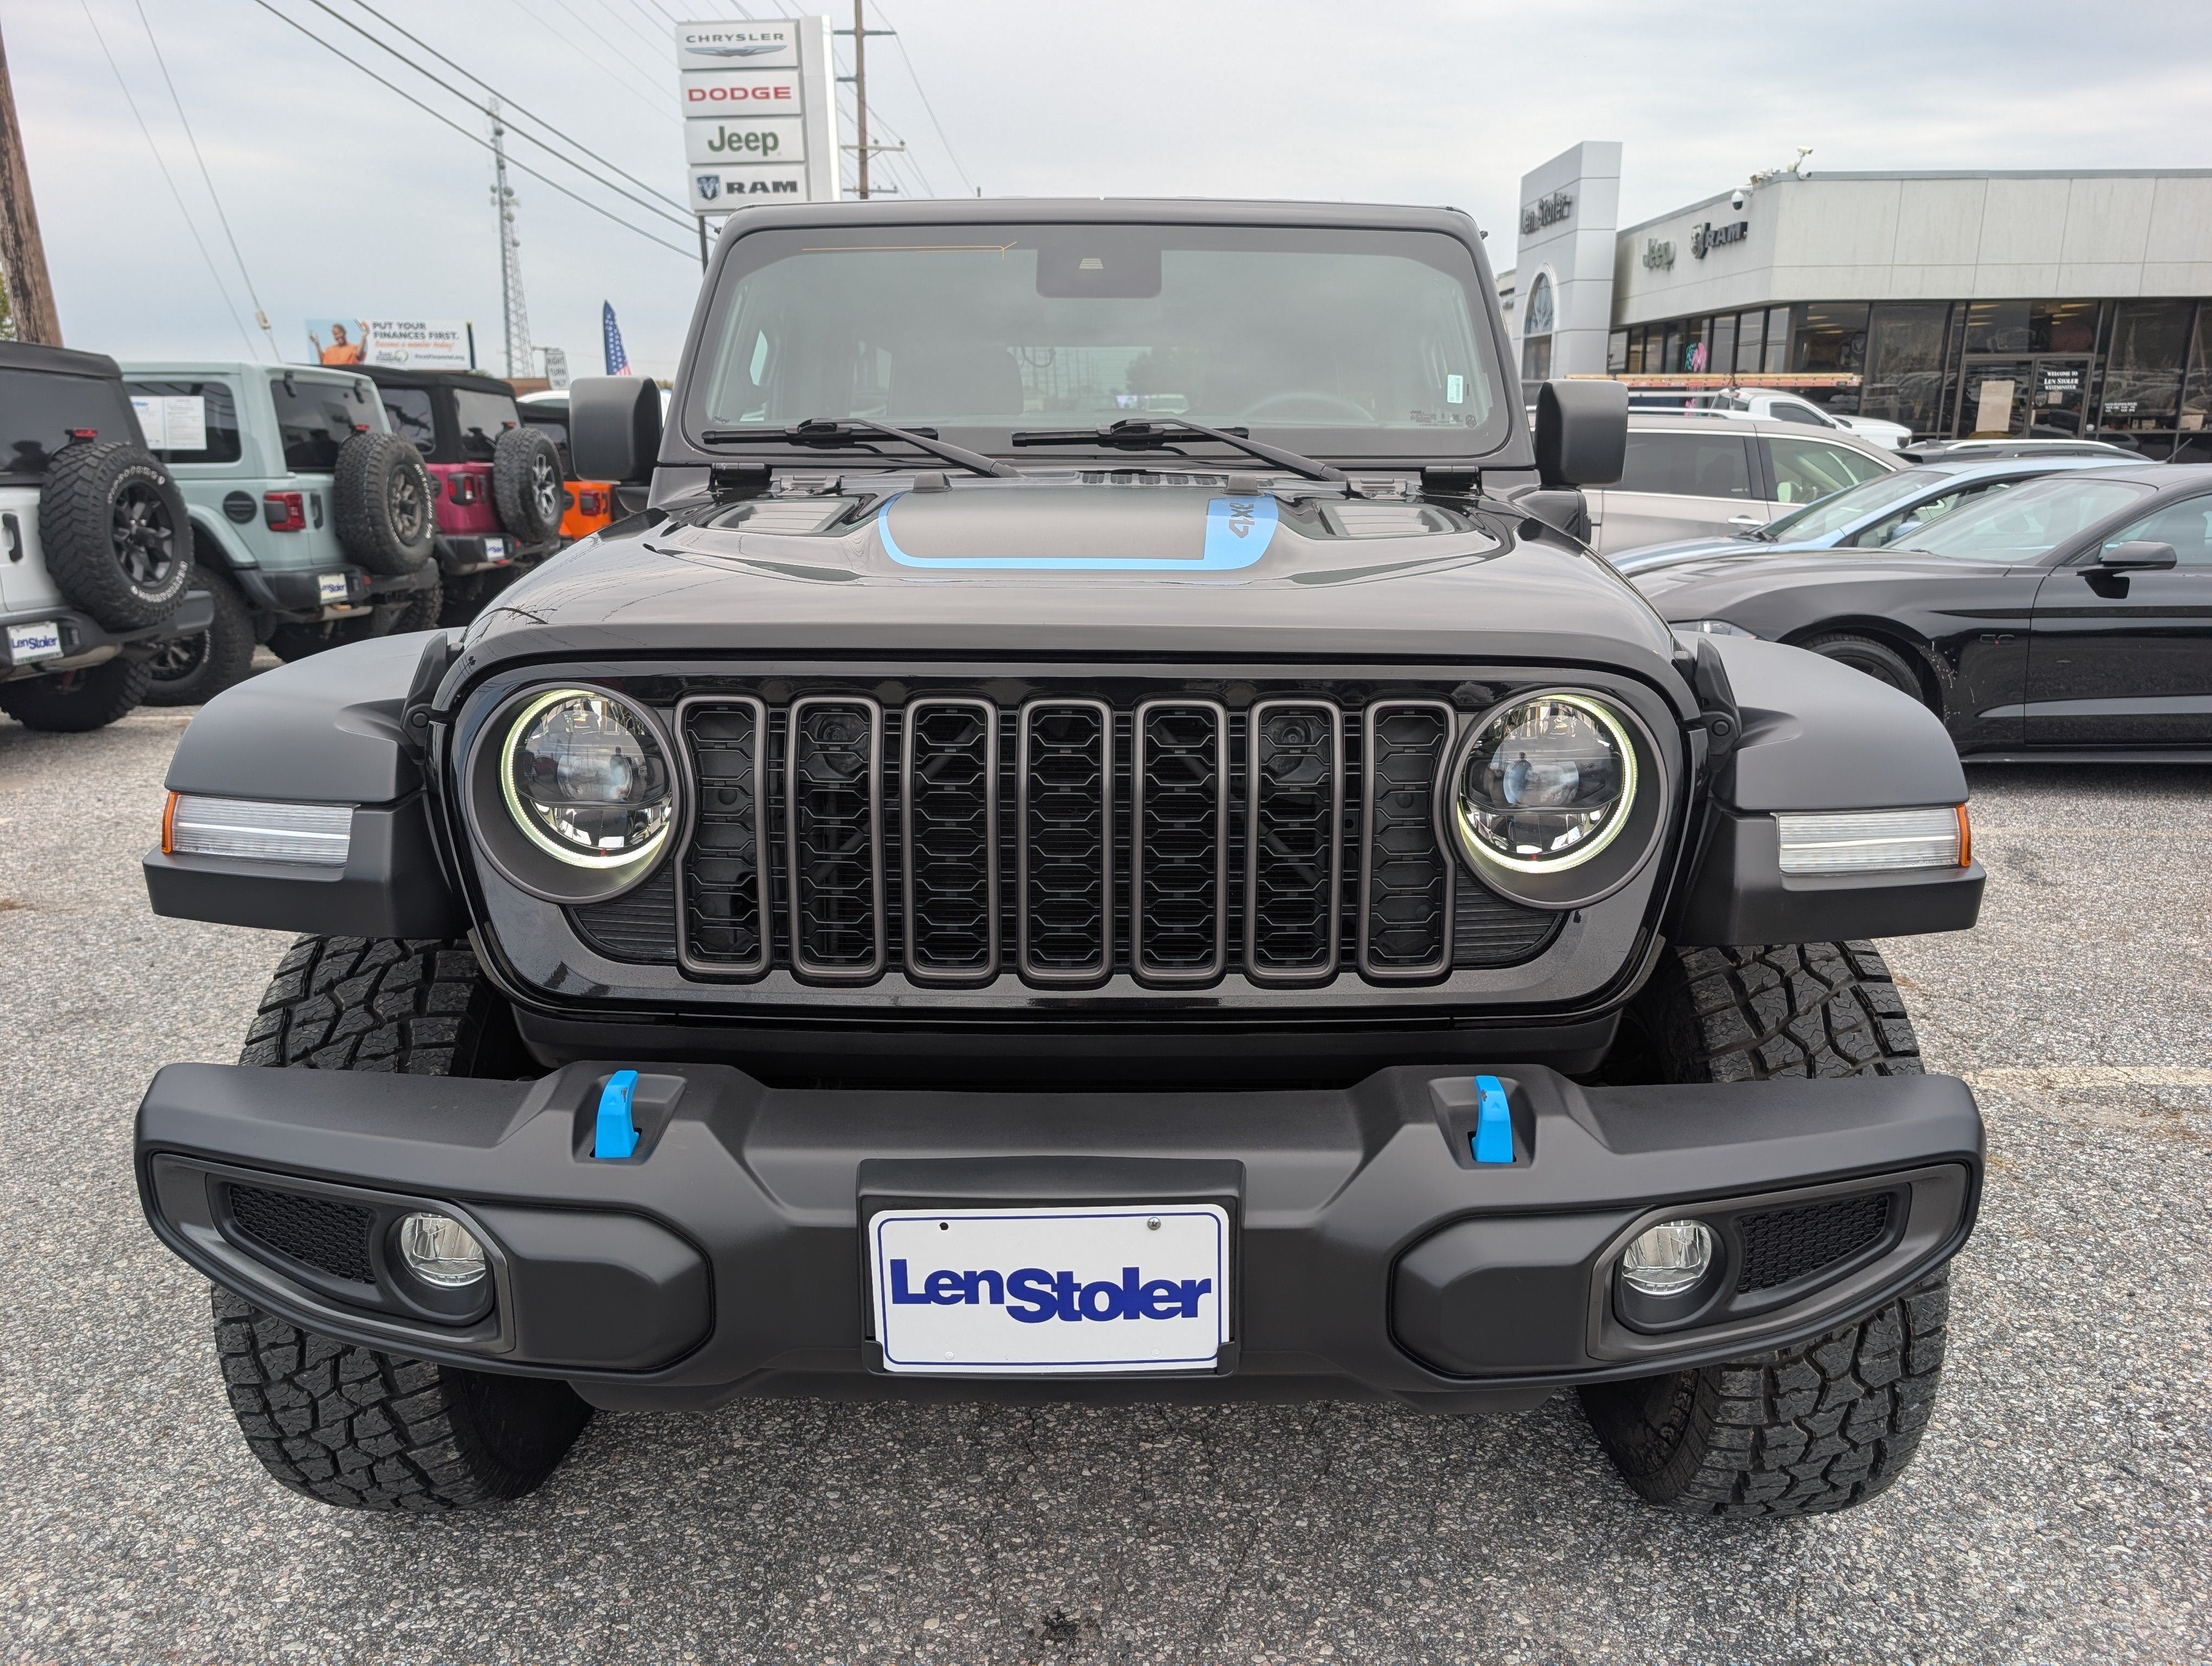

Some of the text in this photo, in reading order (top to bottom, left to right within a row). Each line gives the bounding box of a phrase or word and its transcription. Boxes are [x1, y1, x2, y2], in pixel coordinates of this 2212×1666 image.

[685, 33, 785, 43] CHRYSLER
[687, 86, 792, 102] DODGE
[707, 126, 779, 156] Jeep
[726, 181, 798, 194] RAM
[1519, 193, 1571, 235] Len Stoler
[1705, 221, 1747, 247] RAM
[1642, 238, 1675, 270] Jeep
[372, 322, 393, 330] PUT
[373, 331, 459, 339] FINANCES FIRST.
[890, 1259, 1212, 1323] LenStoler
